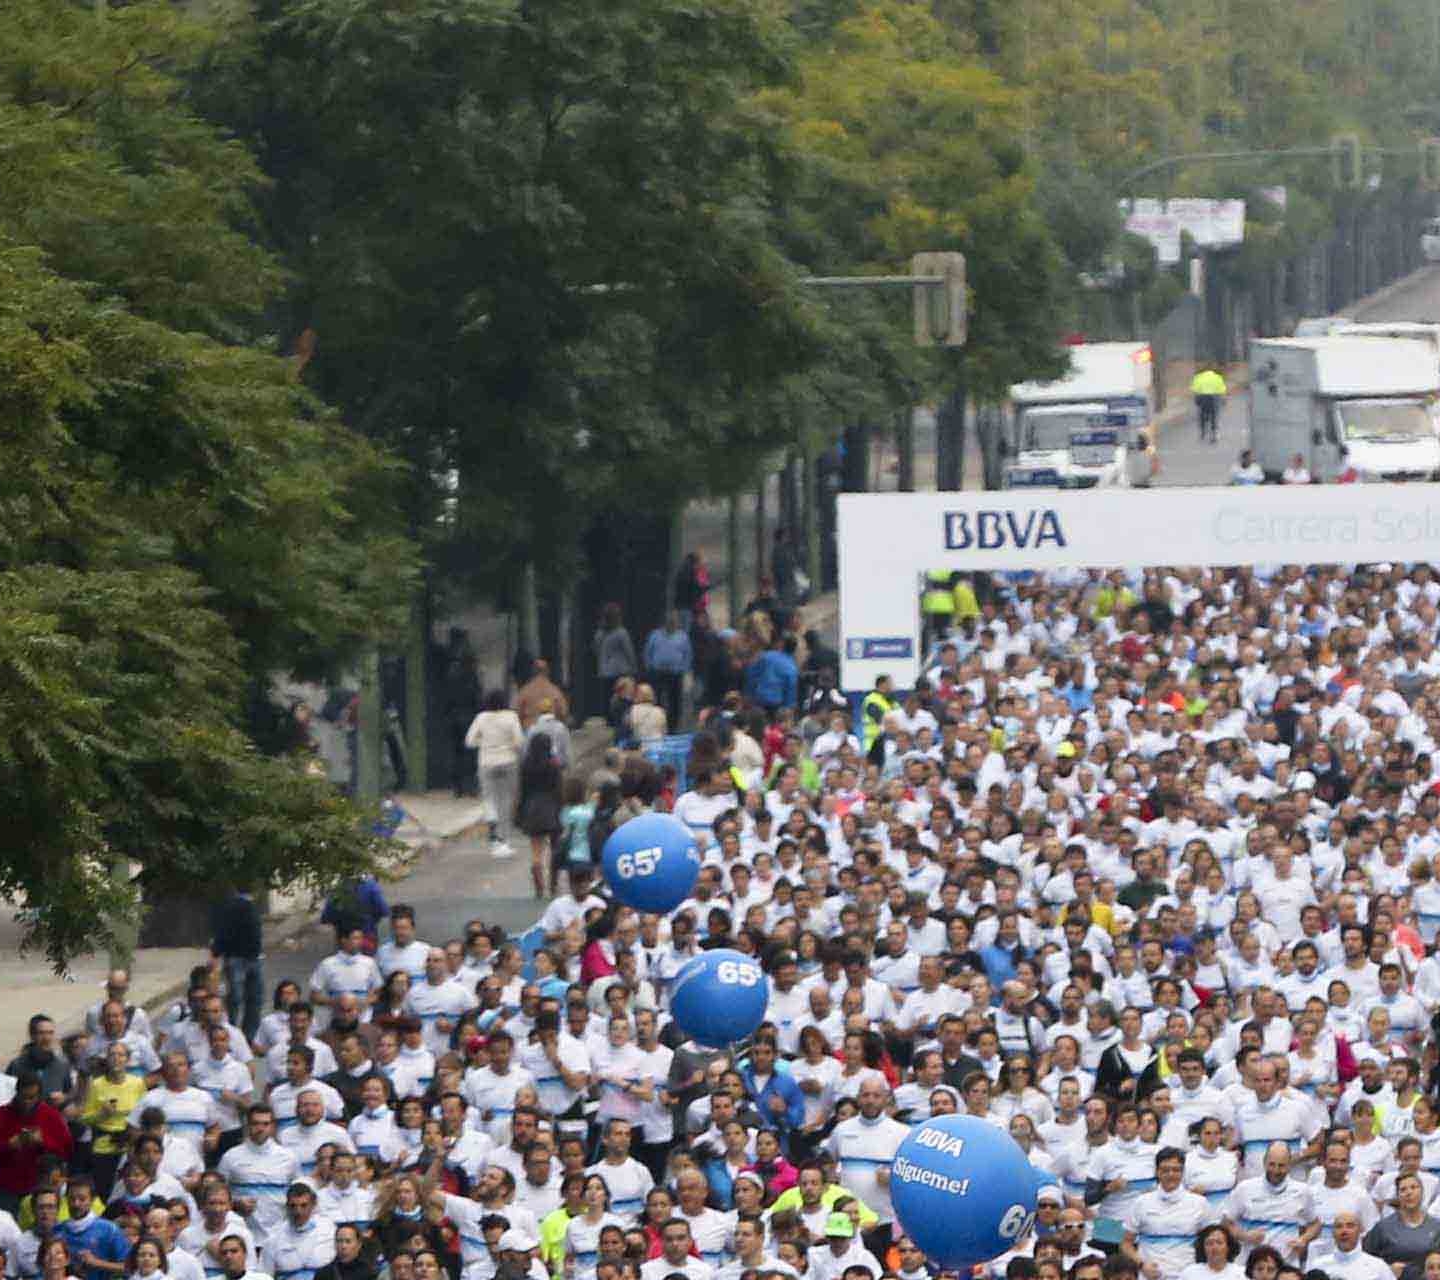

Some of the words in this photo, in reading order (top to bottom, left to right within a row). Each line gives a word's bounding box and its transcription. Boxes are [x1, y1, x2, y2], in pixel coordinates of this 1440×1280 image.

[944, 510, 1066, 549] BBVA
[1215, 505, 1359, 545] Carrera
[616, 847, 662, 879] 65'
[916, 1127, 964, 1157] BBVA
